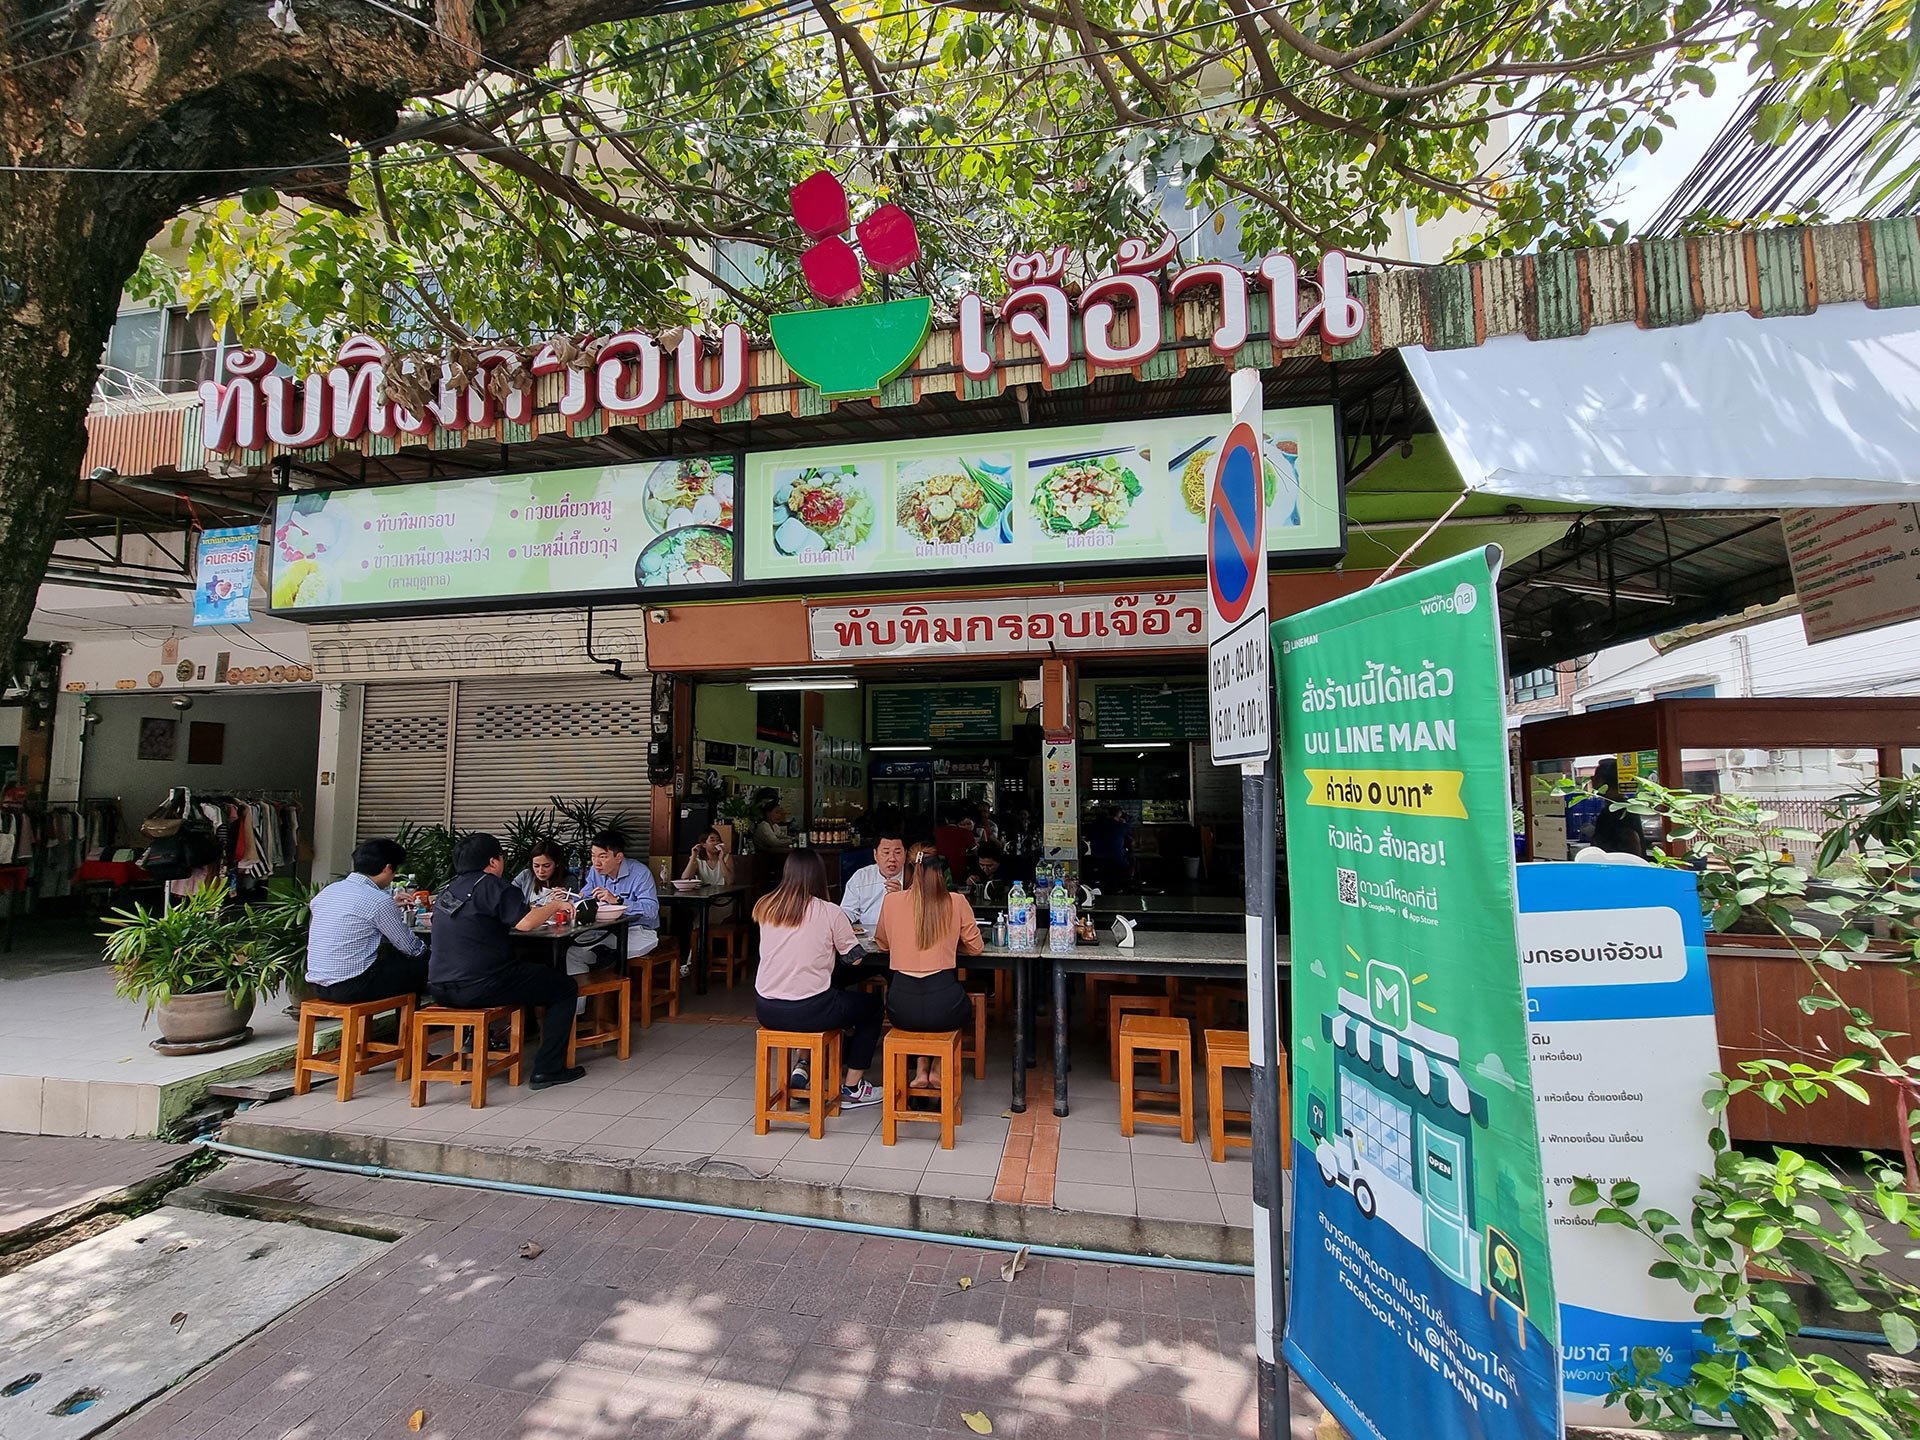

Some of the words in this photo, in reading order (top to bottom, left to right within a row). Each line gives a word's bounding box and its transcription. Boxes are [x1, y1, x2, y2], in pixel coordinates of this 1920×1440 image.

[959, 231, 1366, 381] เจ๊อ้วน
[375, 511, 456, 533] ทับทิมกรอบ
[205, 544, 254, 566] คนละครึ่ง
[373, 538, 491, 570] ข้าวเหนียวมะม่วง
[521, 527, 618, 560] บะหมี่เกี๊ยวกุ้ง
[914, 537, 994, 559] ผัดไทยกุ้งสด
[387, 573, 452, 592] (ตามฤดูกาล)
[1421, 587, 1475, 616] wongnai
[1301, 660, 1454, 713] สั่งร้านนี้ได้แล้ว
[1304, 731, 1330, 755] บน
[1335, 725, 1384, 753] LINE
[1389, 720, 1457, 752] MAN
[1326, 776, 1362, 803] ค่าส่ง
[1368, 782, 1382, 804] 0
[1328, 825, 1373, 855] หิวแล้ว
[1378, 826, 1446, 866] สั่งเลย!
[1360, 879, 1438, 911] ดาวน์โหลดที่นี่
[1368, 901, 1385, 913] Google
[1385, 904, 1396, 916] Play
[1409, 912, 1420, 923] App
[1420, 915, 1439, 927] Store
[1531, 1033, 1551, 1045] ดิม
[1540, 1050, 1583, 1062] แห้วเชื่อม)
[1544, 1091, 1584, 1102] แห้วเชื่อม
[1549, 1132, 1605, 1143] ฟักทองเชื่อม
[1609, 1131, 1644, 1143] มันเชื่อม
[1428, 1154, 1452, 1176] OPEN
[1324, 1237, 1362, 1279] Official
[1363, 1273, 1414, 1326] Account
[1425, 1327, 1508, 1410] @lineman
[1339, 1270, 1396, 1330] Facebook
[1406, 1330, 1440, 1372] LINE
[1443, 1367, 1479, 1412] MAN
